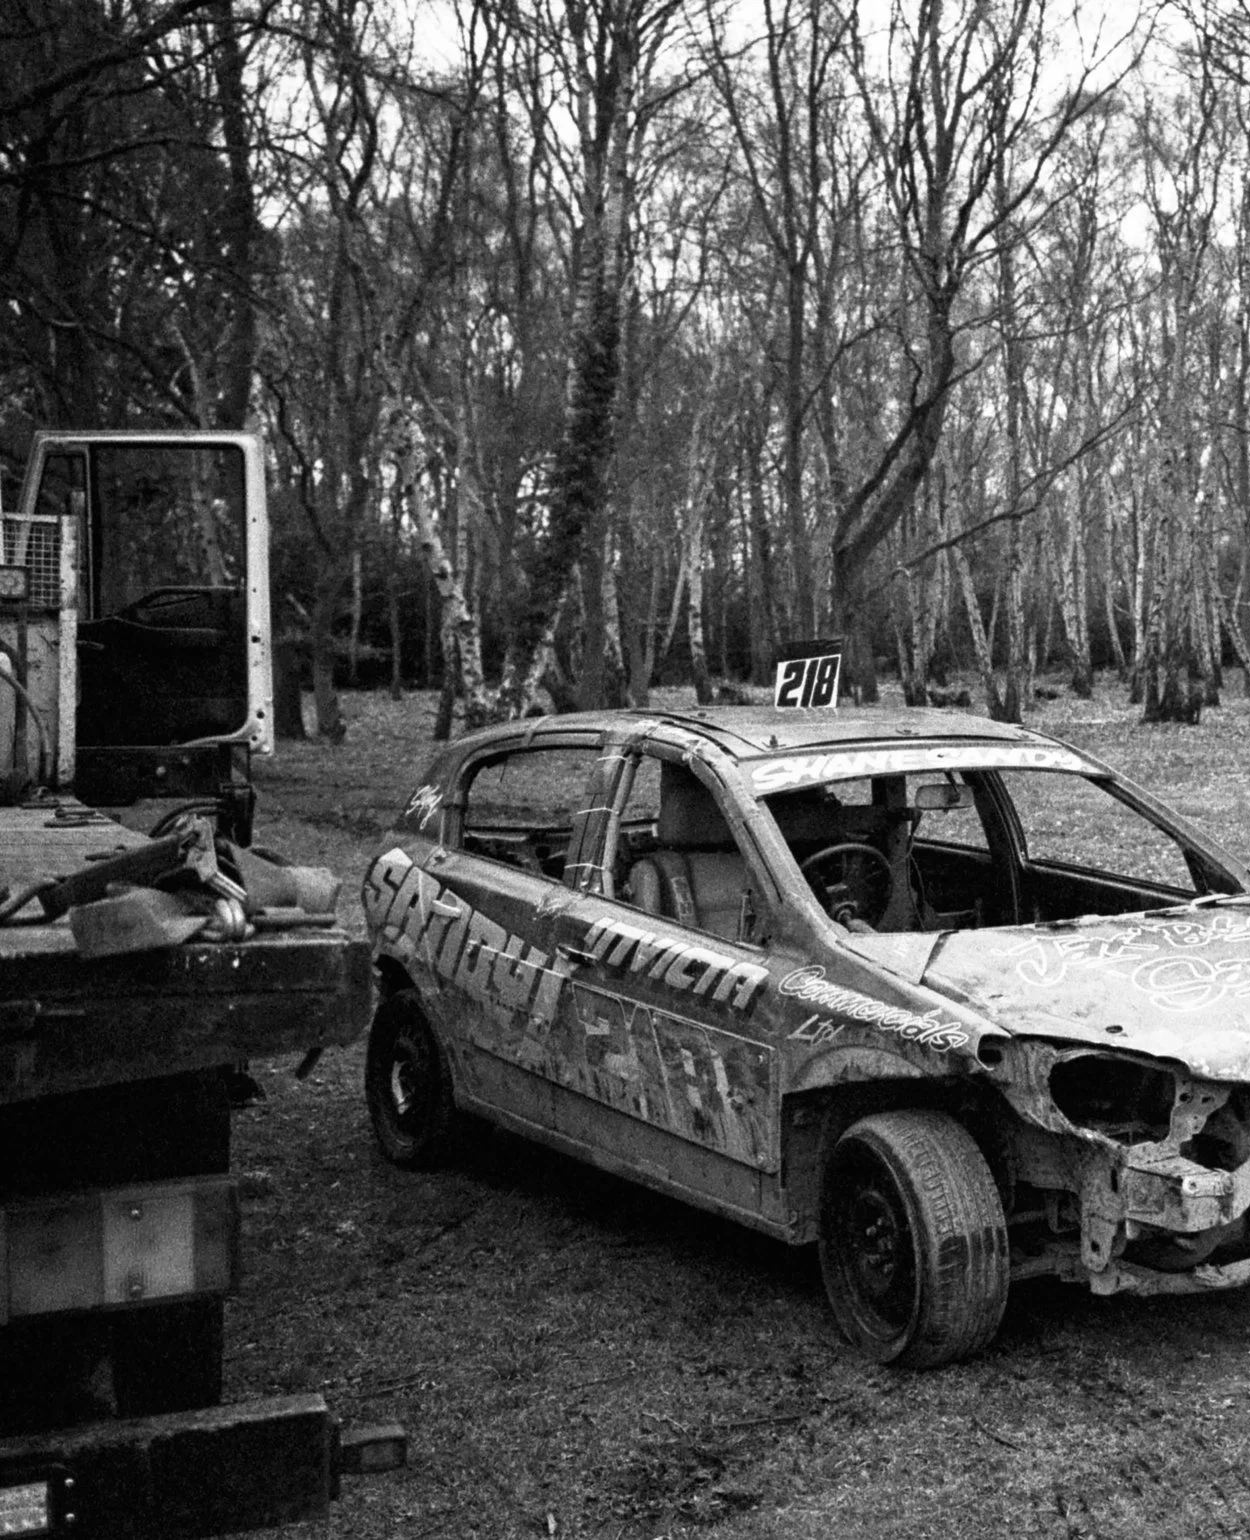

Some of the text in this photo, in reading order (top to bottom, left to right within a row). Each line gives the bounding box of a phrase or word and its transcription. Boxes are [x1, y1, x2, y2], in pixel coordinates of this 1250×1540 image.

[777, 656, 840, 707] 218
[751, 750, 921, 791] SHANE
[584, 917, 770, 1010] INVICTA
